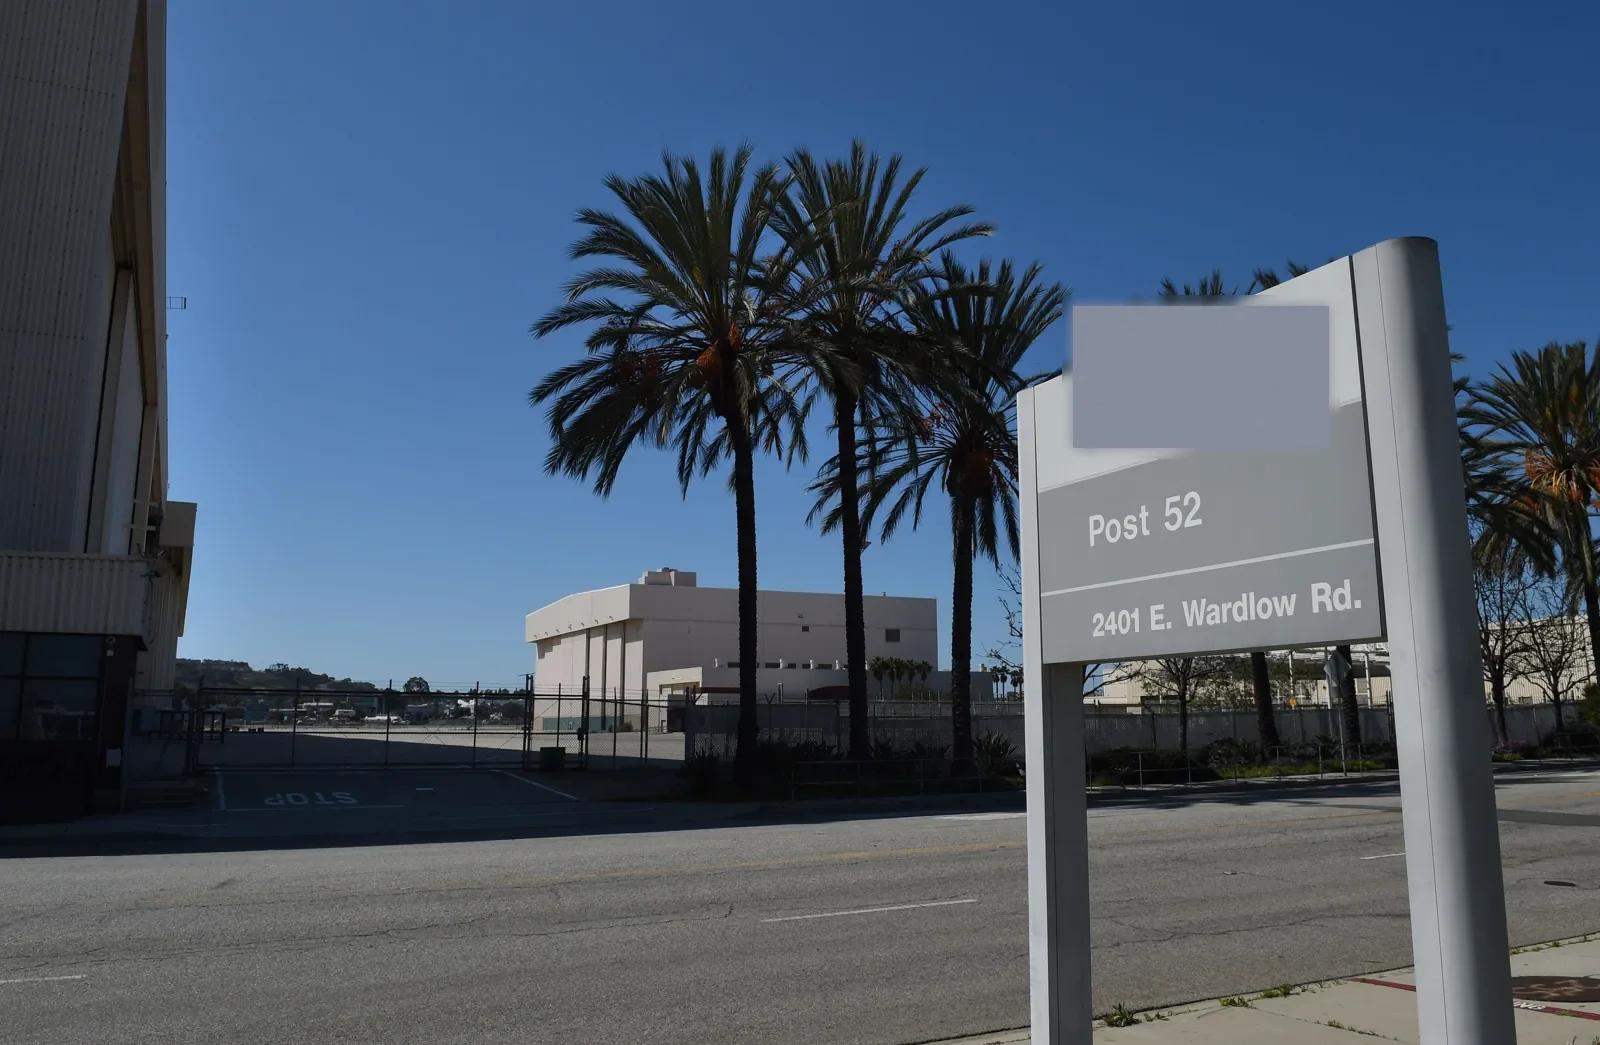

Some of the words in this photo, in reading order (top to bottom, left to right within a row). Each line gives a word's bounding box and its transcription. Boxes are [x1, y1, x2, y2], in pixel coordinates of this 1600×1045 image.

[1088, 505, 1150, 547] Post
[1164, 491, 1203, 531] 52
[1092, 607, 1140, 637] 2401
[1149, 603, 1172, 631] E.
[1181, 591, 1297, 627] Wardlow
[1310, 578, 1362, 614] Rd.
[263, 791, 358, 806] STOP
